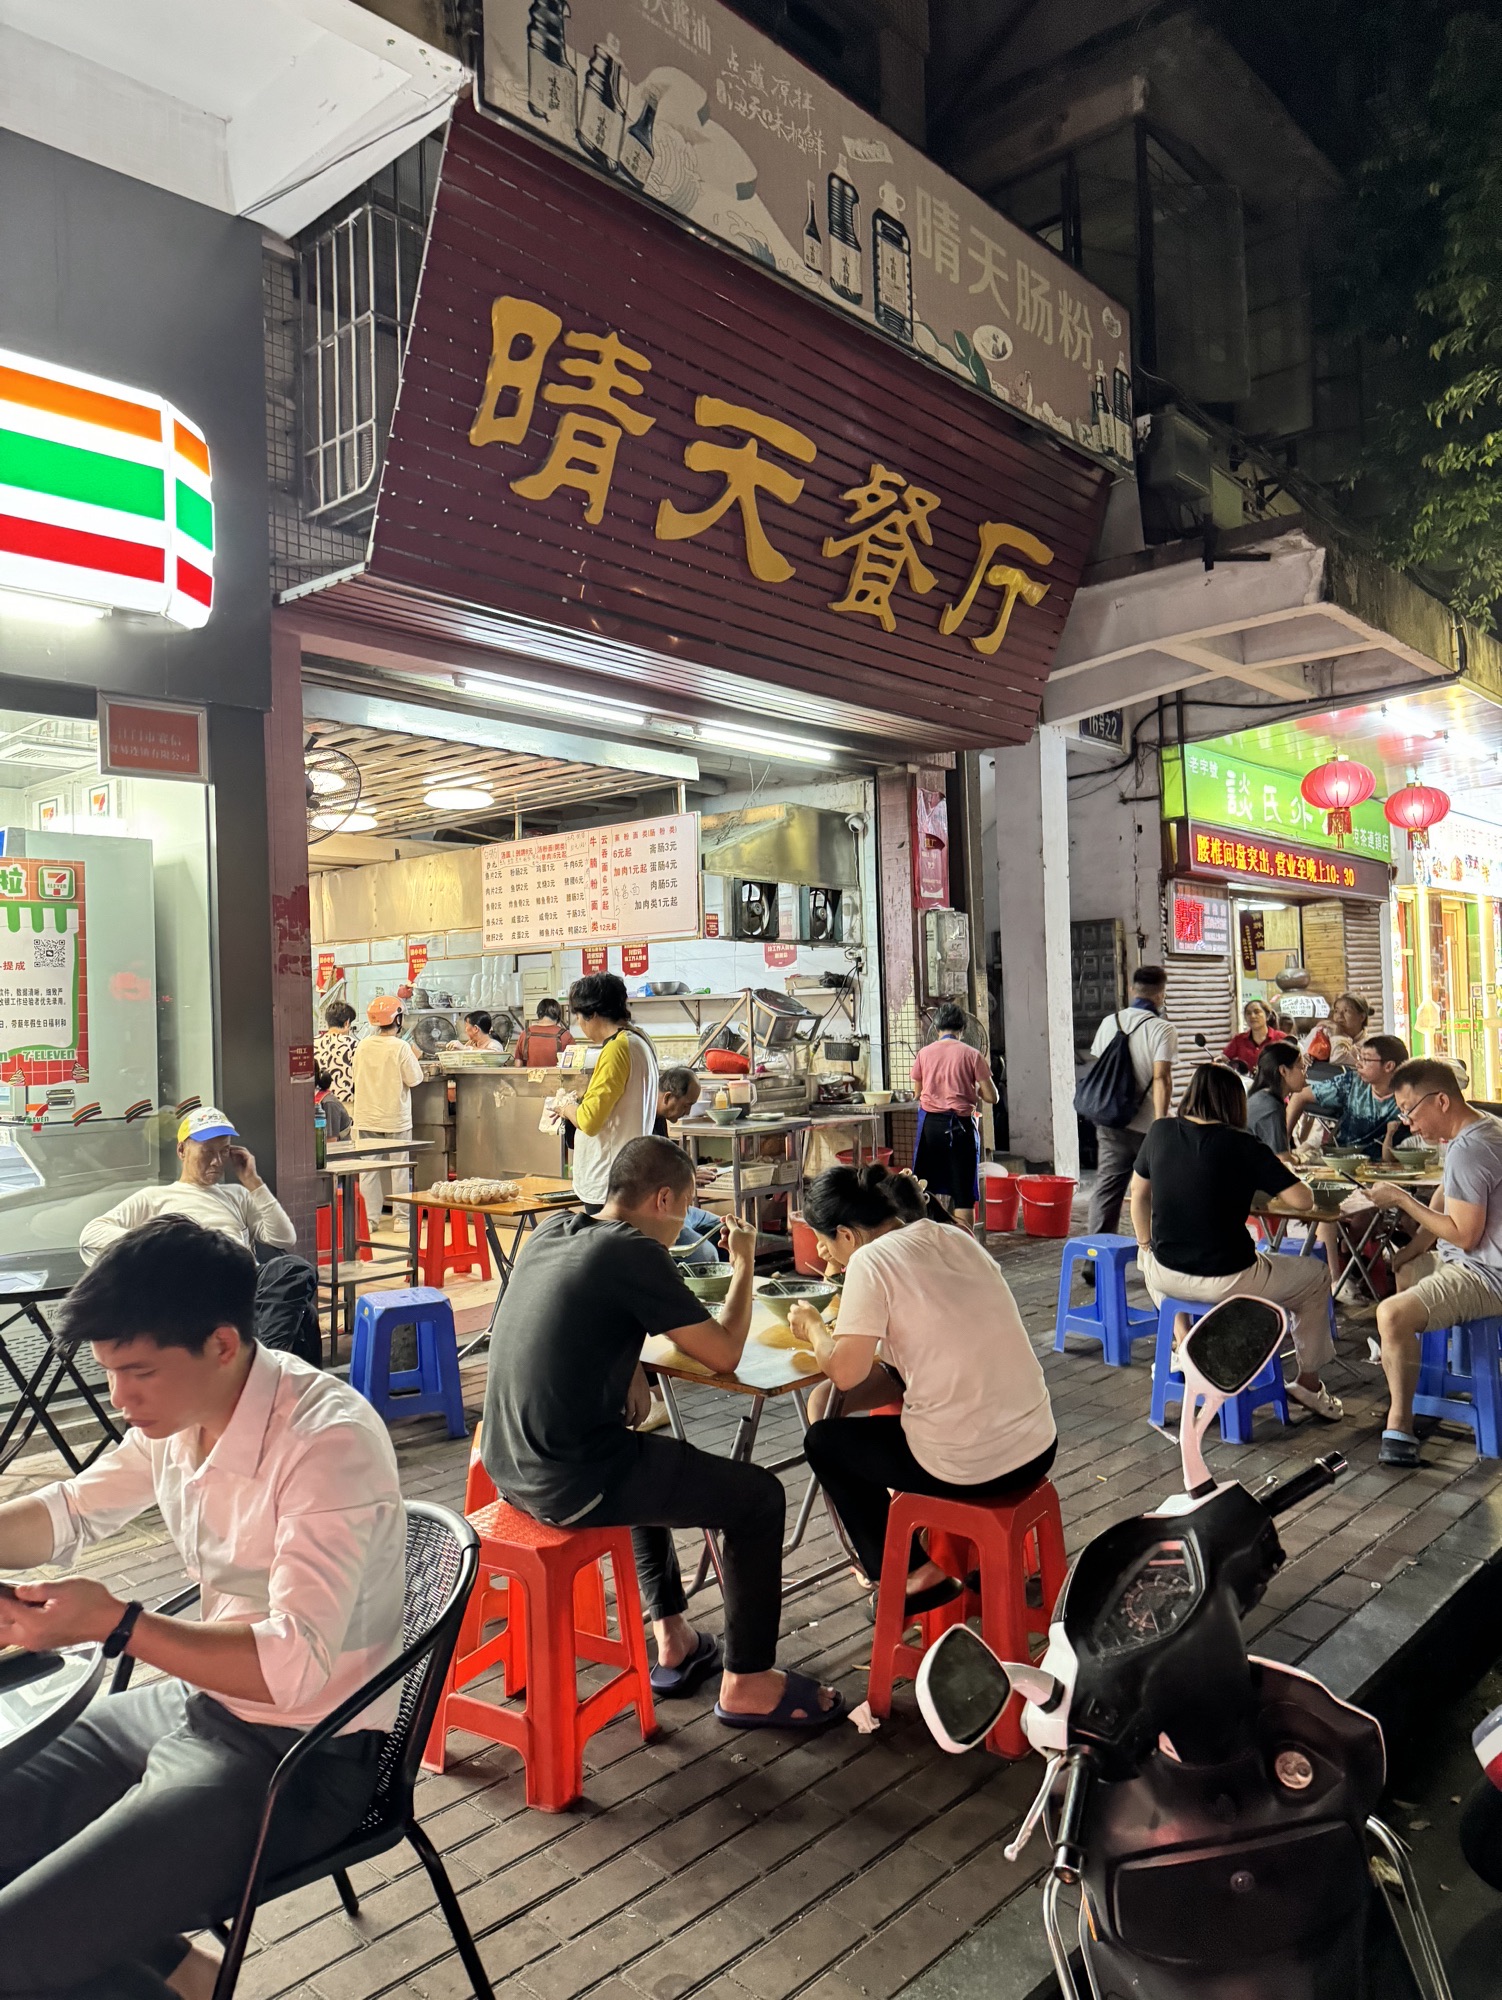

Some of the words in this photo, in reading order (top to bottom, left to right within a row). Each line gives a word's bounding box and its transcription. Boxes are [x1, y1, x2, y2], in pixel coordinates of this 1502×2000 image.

[915, 185, 1094, 370] 晴天肠粉
[469, 294, 1055, 655] 晴天餐厅
[613, 847, 632, 858] 6元起
[614, 864, 647, 877] 加肉1元起
[650, 860, 677, 873] 蛋肠4元
[650, 878, 678, 890] 肉肠5元
[634, 896, 678, 910] 加肉类1元起
[600, 923, 617, 931] 12元起
